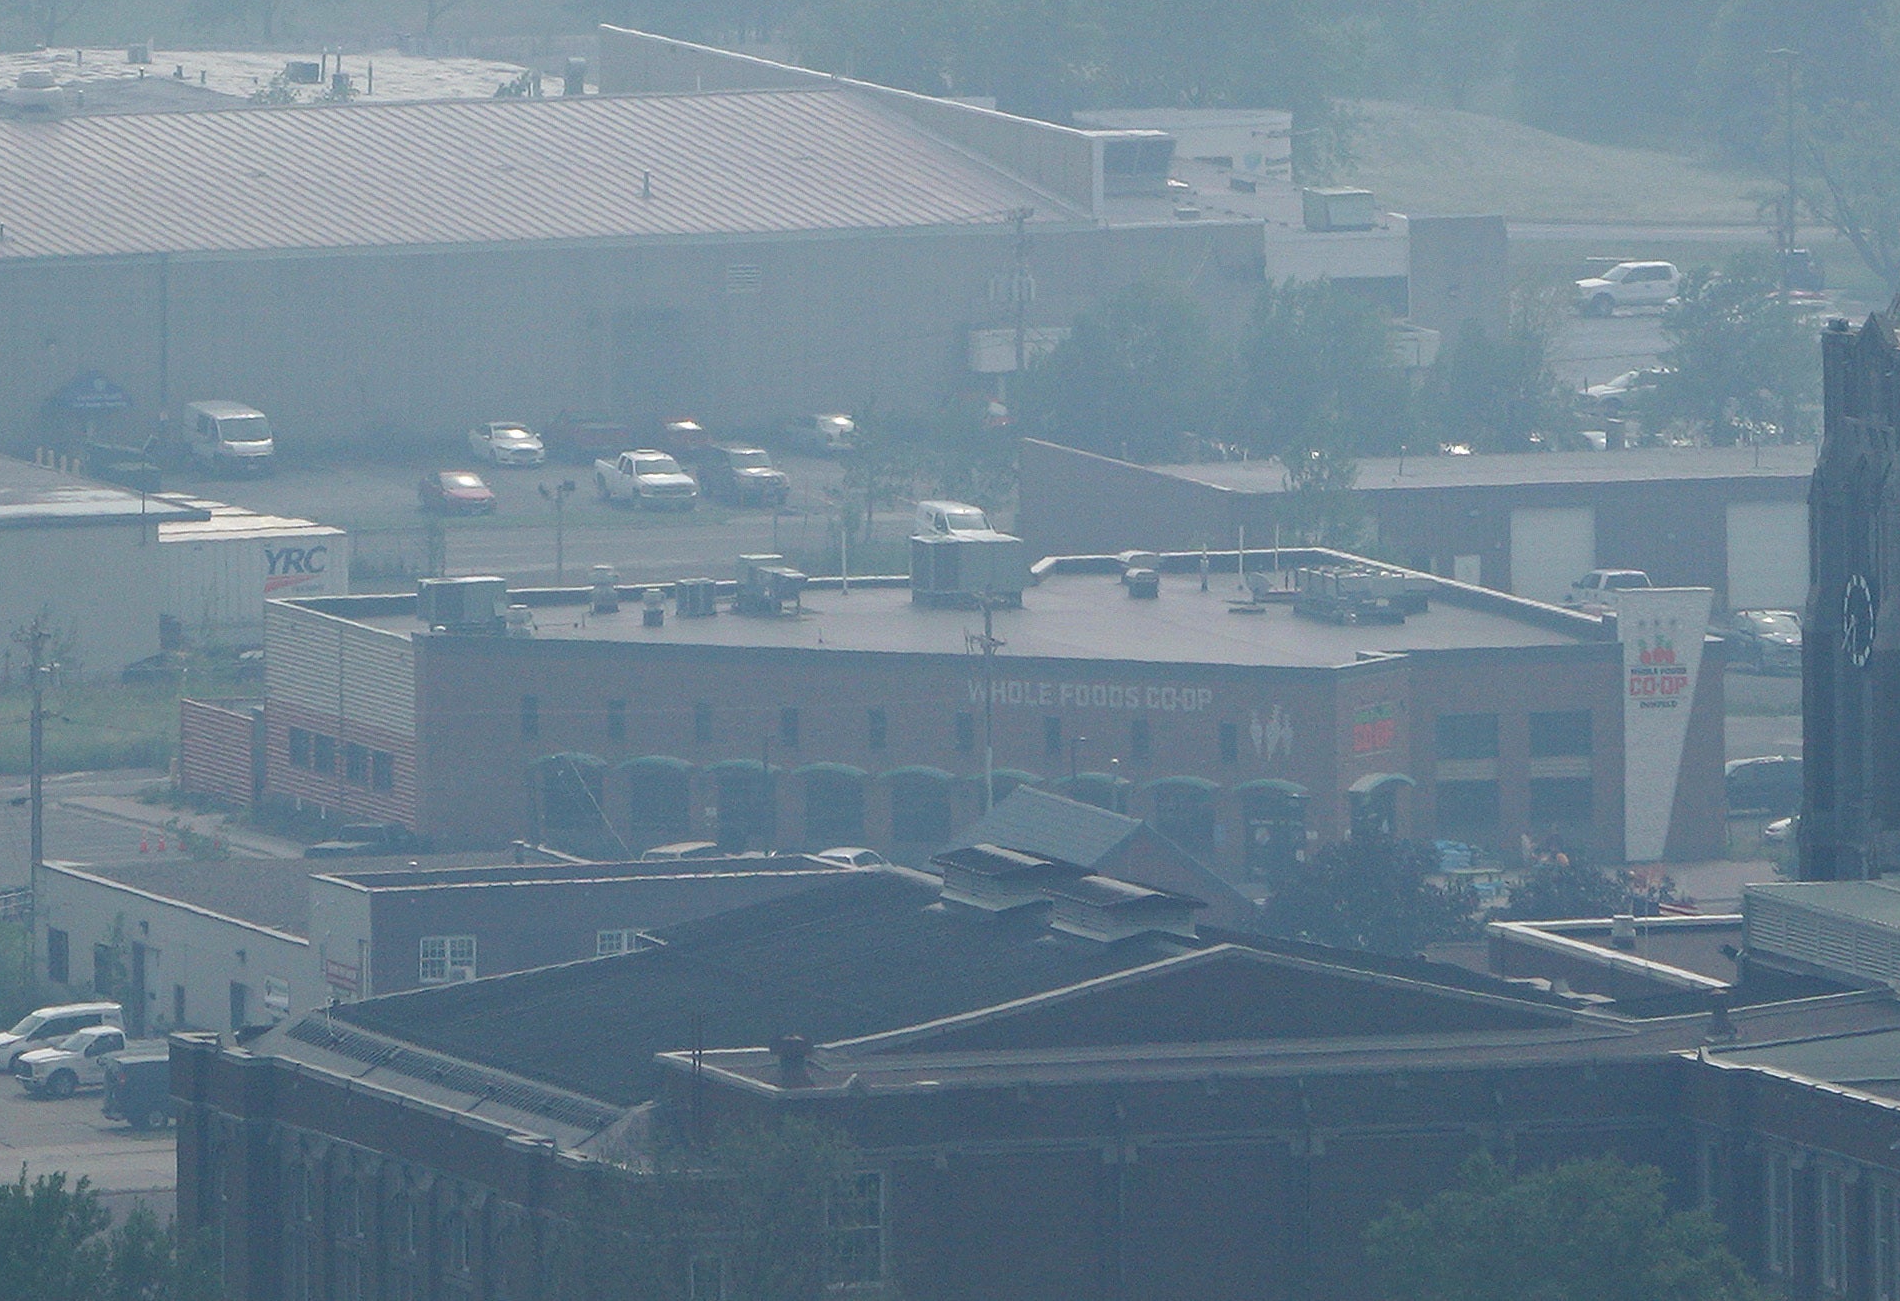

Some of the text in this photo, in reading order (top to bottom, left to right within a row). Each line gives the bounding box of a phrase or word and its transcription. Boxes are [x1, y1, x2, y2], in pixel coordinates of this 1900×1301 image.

[264, 545, 328, 574] YRC
[967, 679, 1052, 705] WHOLE
[1058, 682, 1140, 710] FOODS
